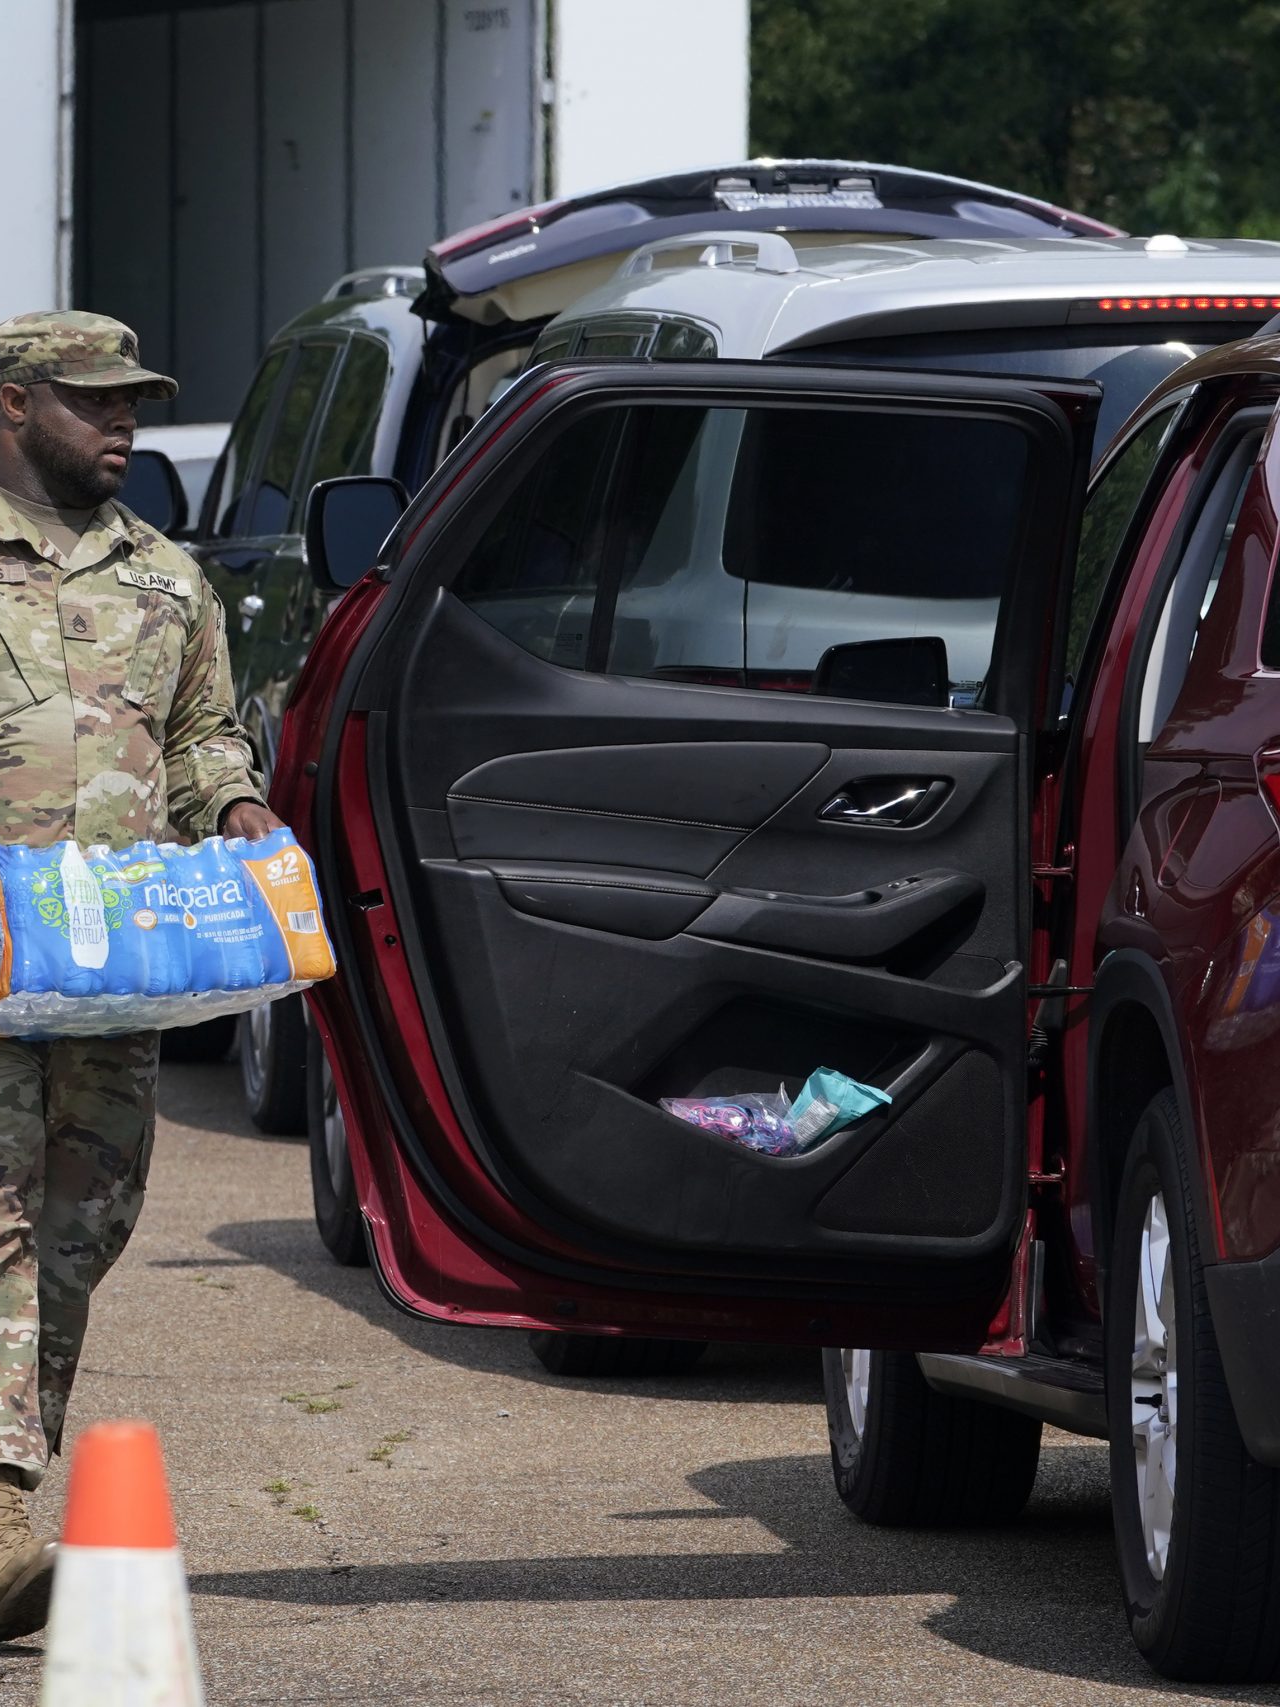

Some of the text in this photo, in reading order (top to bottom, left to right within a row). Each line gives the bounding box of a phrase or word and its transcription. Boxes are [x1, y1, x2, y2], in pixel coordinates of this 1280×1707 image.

[149, 575, 178, 592] ARMY
[267, 852, 300, 881] 32
[271, 875, 301, 888] BOTELLAS
[66, 880, 100, 906] VIDA
[144, 880, 244, 911] niagara
[72, 905, 102, 926] A ESTA
[204, 910, 246, 923] PURIFICADA
[72, 927, 105, 946] BOTELLA
